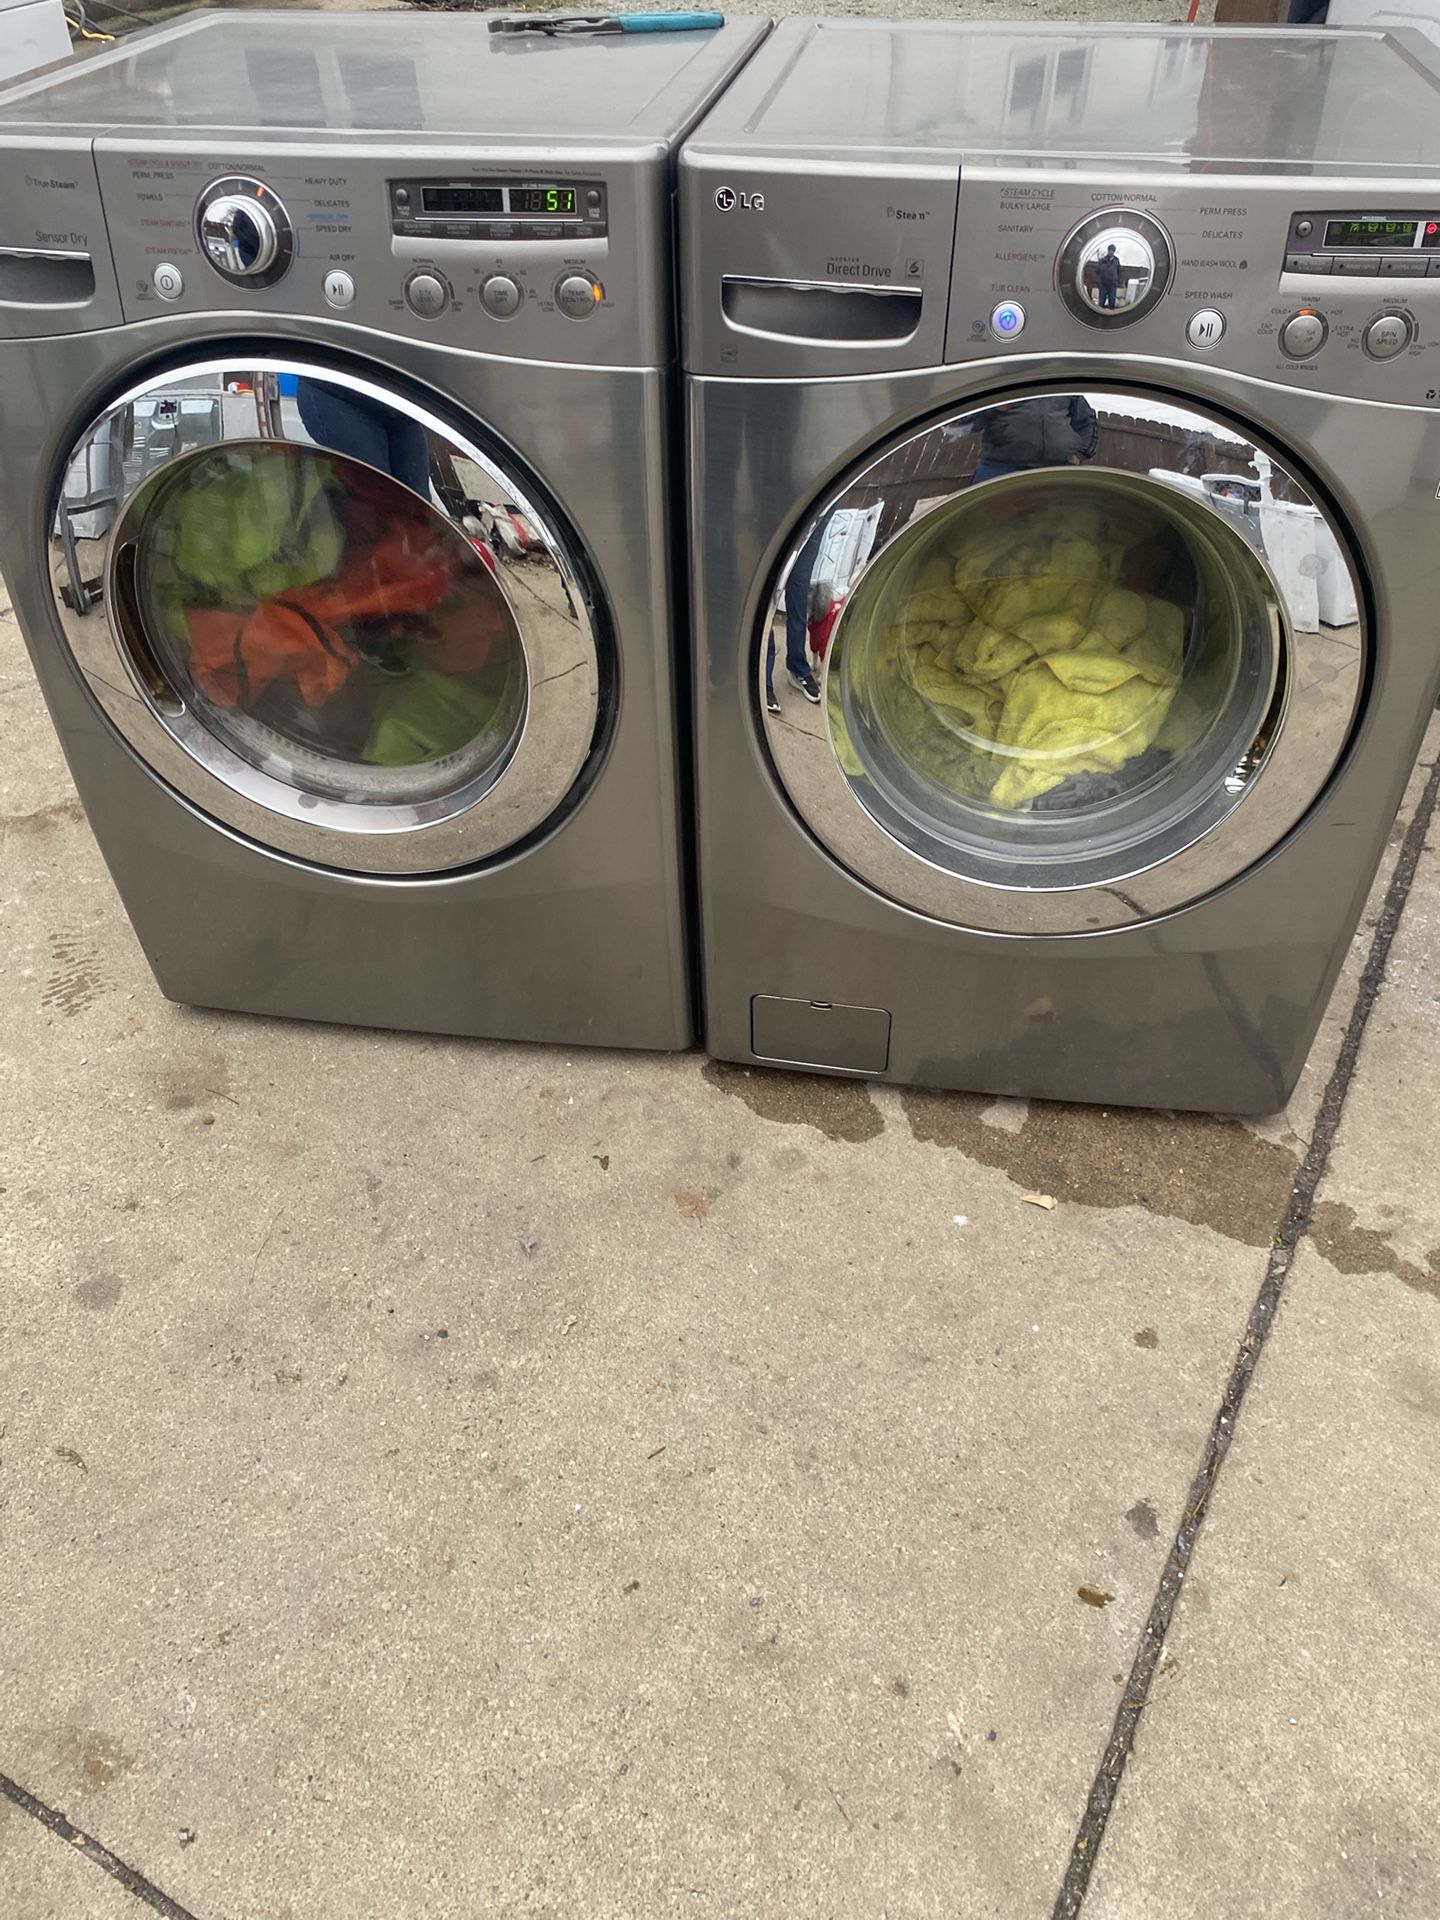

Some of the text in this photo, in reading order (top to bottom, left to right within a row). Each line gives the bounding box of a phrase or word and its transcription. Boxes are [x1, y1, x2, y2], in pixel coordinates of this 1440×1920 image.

[153, 172, 174, 180] PRESS
[305, 177, 347, 186] HEAVY DUTY
[136, 193, 163, 201] TOWELS
[1031, 189, 1056, 198] CYCLE
[314, 199, 350, 208] DELICATES
[546, 190, 572, 210] 51
[739, 192, 765, 211] LG
[1223, 208, 1248, 216] PRESS
[316, 224, 352, 233] SPEED DRY
[998, 225, 1033, 233] SANITARY
[35, 229, 88, 247] Sensor Dry
[1202, 230, 1243, 239] DELICATES
[341, 254, 355, 262] DRY
[827, 262, 892, 278] Direct Drive
[1006, 284, 1031, 293] CLEAN
[1185, 291, 1208, 299] SPEED
